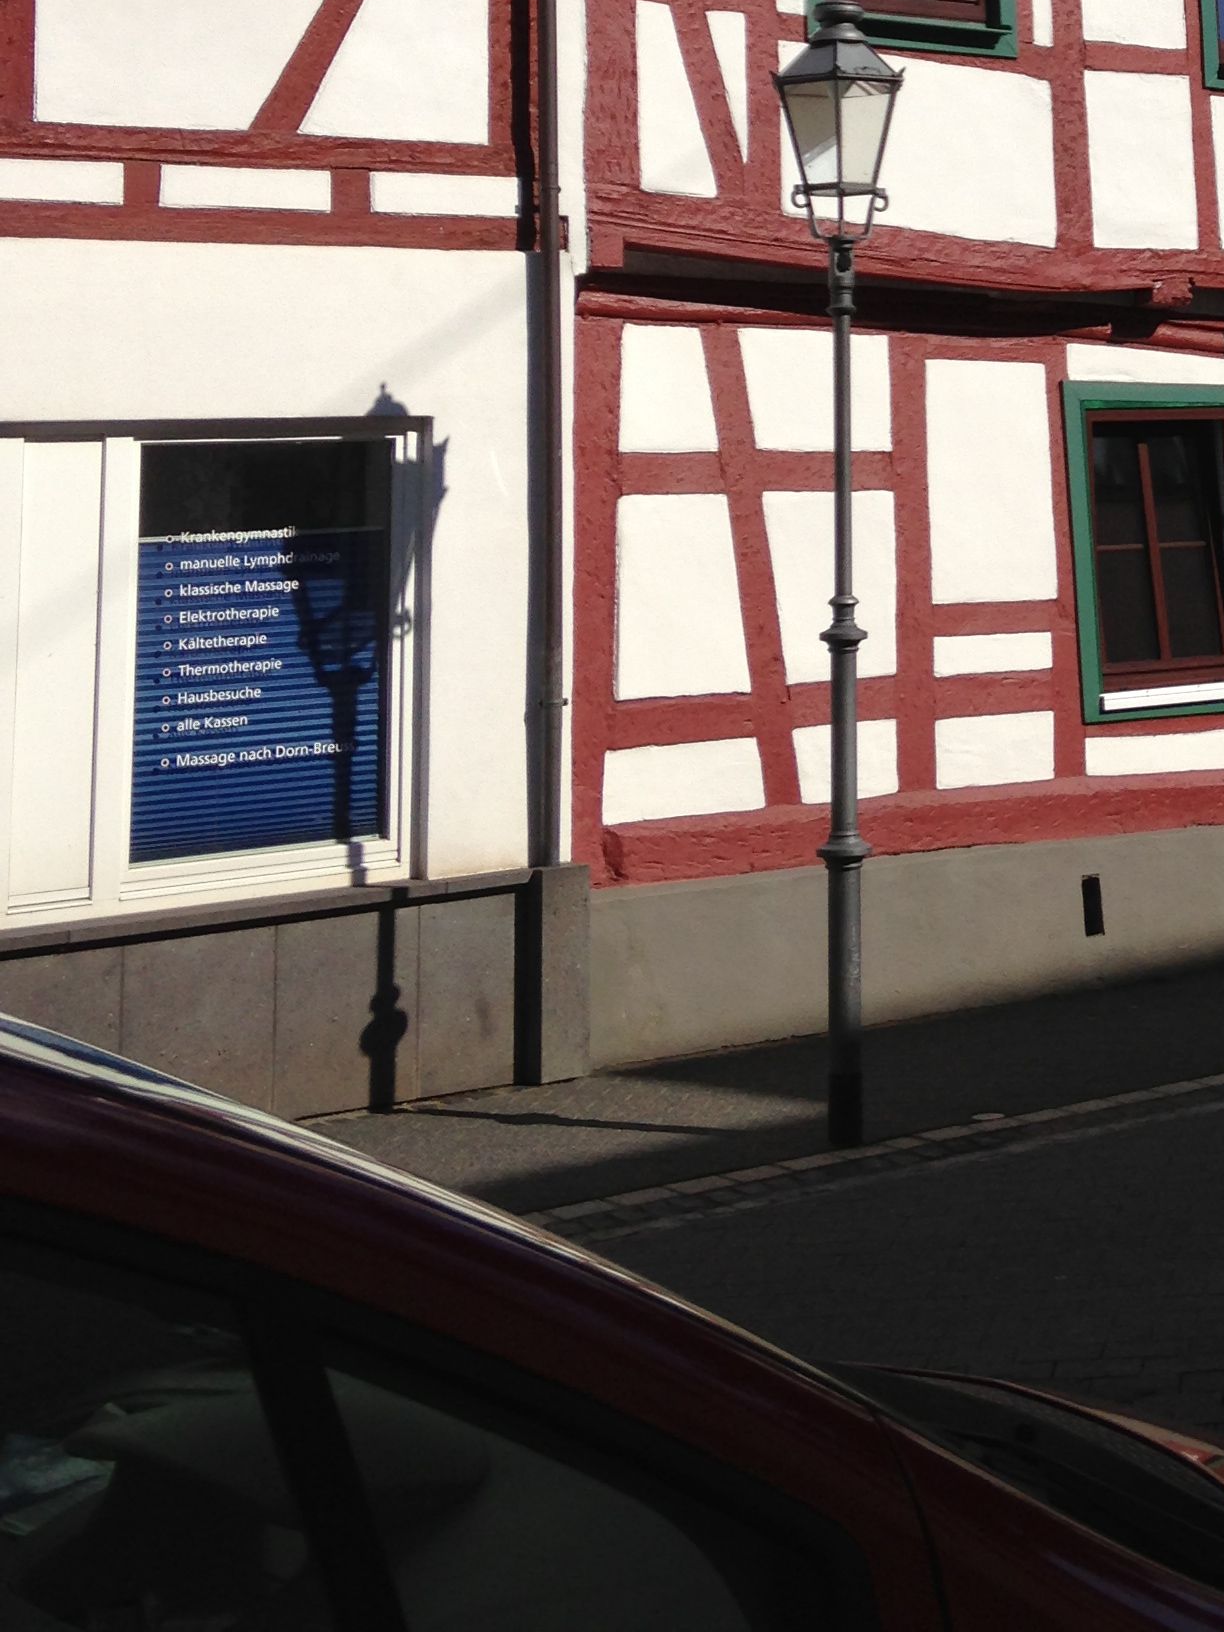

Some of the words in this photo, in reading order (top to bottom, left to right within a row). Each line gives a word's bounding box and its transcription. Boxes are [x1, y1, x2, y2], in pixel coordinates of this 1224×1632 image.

[180, 556, 240, 570] manuelle
[179, 582, 241, 597] klassische
[245, 579, 299, 594] Massage
[179, 605, 279, 624] Elektrotherapie
[179, 633, 267, 650] Kältetherapie
[178, 658, 282, 676] Thermotherapie
[177, 686, 262, 704] Hausbesuche
[176, 719, 200, 732] alle
[204, 715, 248, 730] Kassen
[176, 752, 236, 767] Massage
[239, 747, 271, 760] nach
